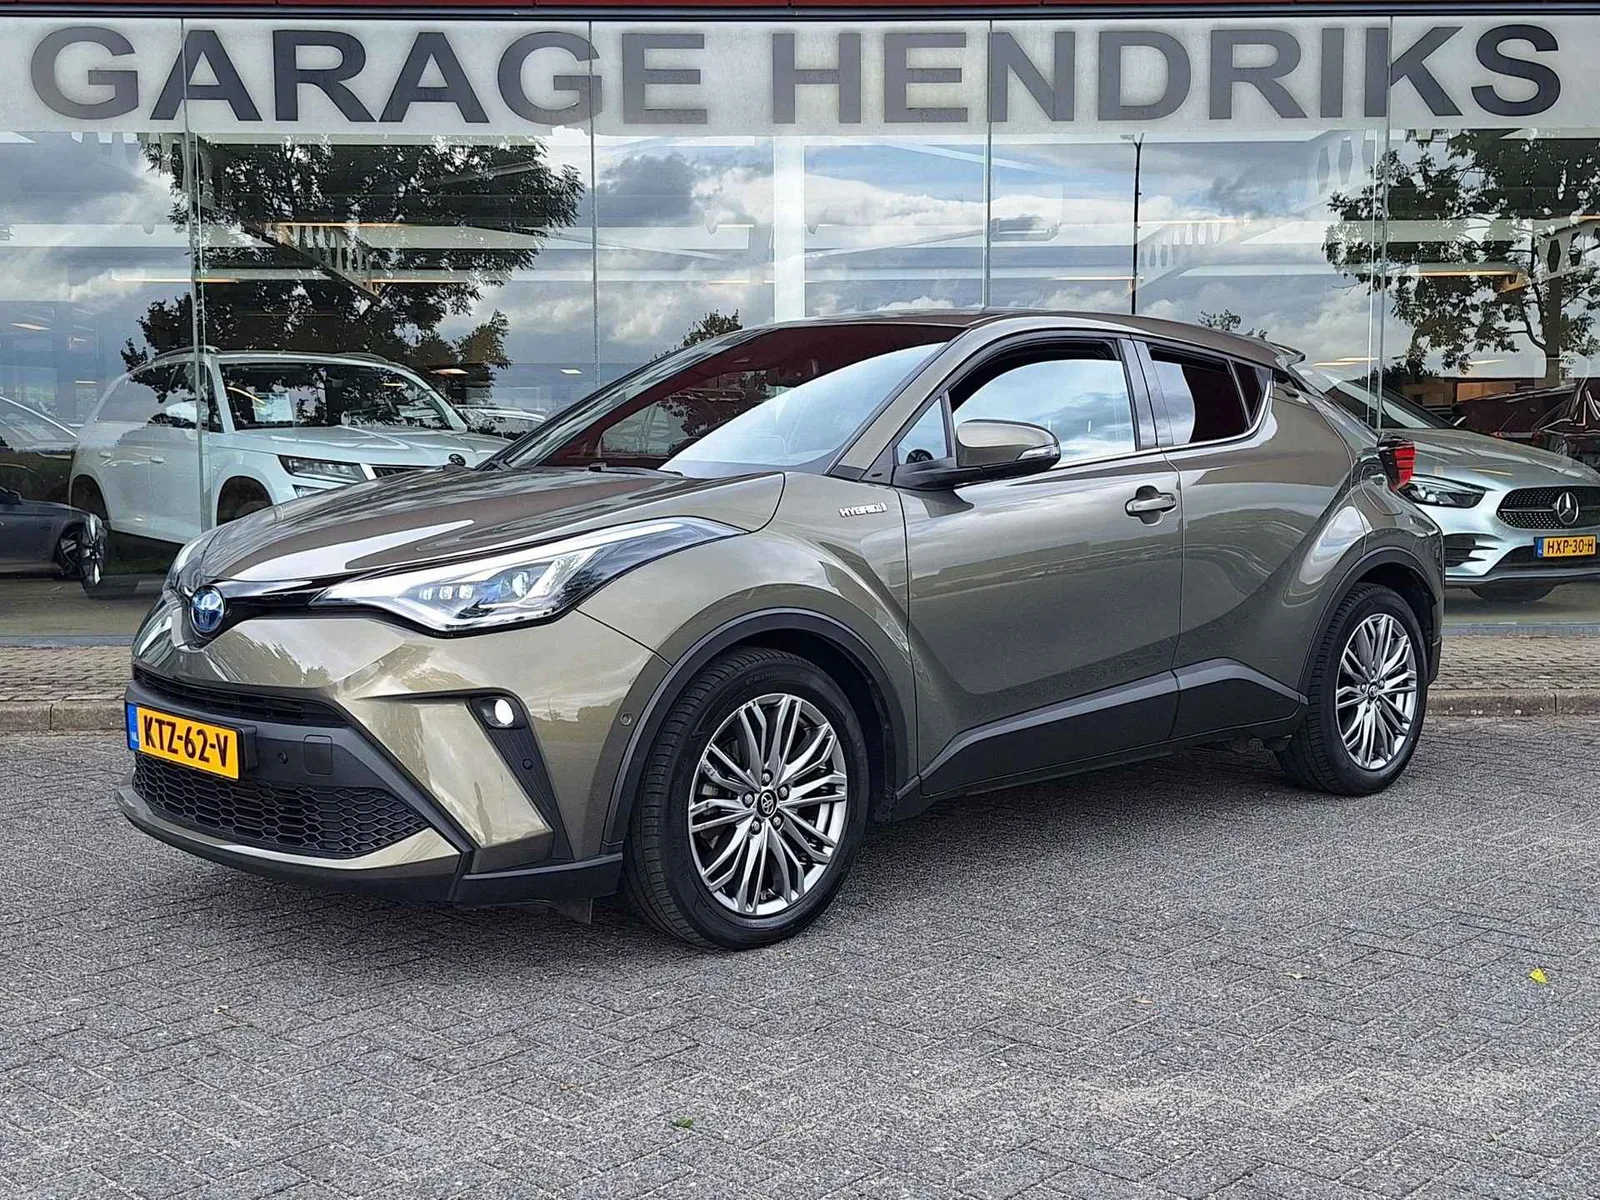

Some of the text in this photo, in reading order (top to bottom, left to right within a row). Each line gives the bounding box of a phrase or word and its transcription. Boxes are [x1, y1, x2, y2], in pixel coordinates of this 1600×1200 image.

[30, 25, 1561, 125] GARAGE HENDRIKS
[1547, 539, 1594, 554] HXP-30-H
[143, 715, 229, 767] KTZ-62-V
